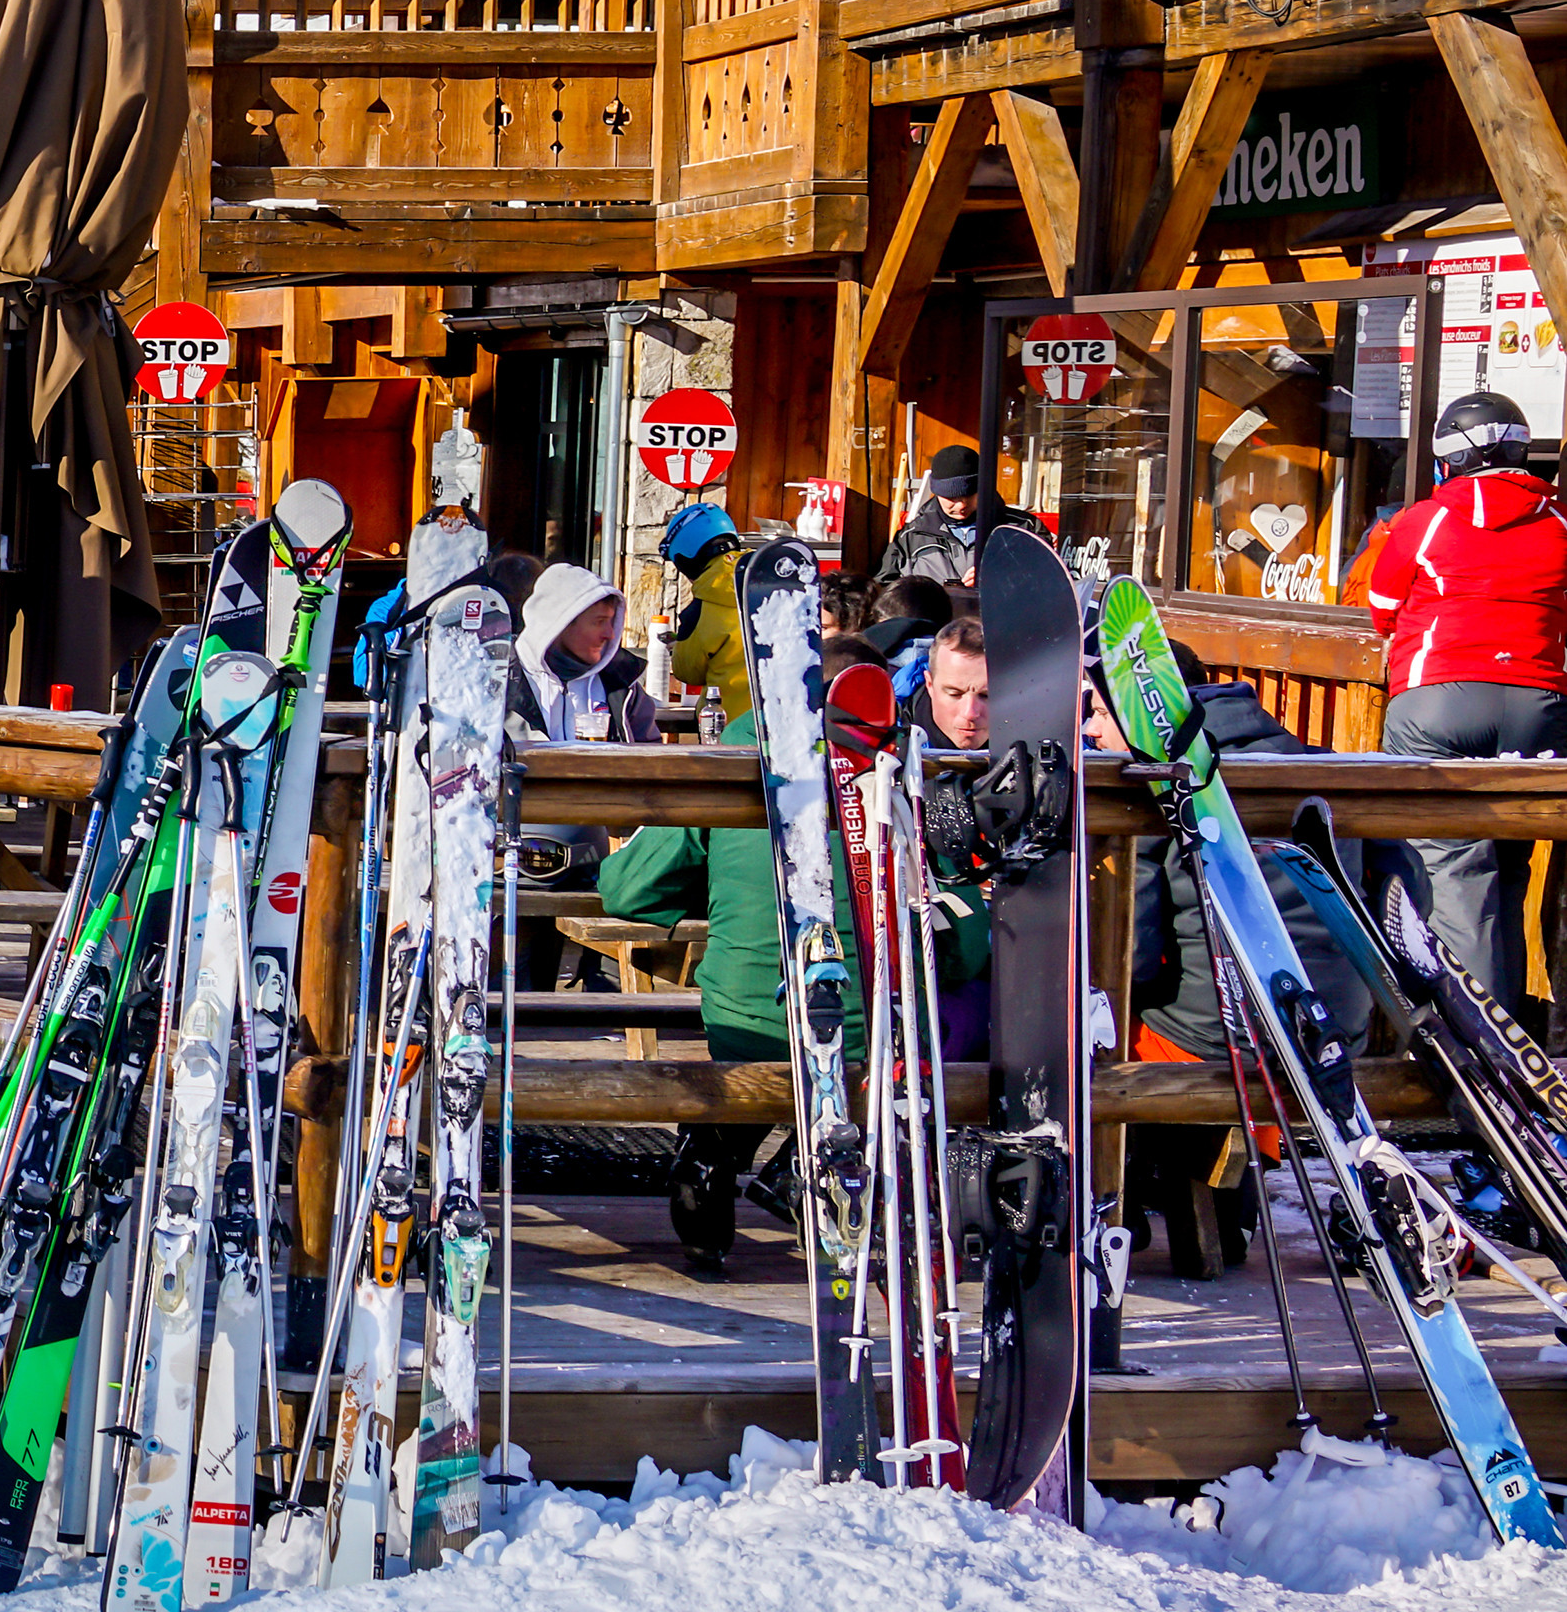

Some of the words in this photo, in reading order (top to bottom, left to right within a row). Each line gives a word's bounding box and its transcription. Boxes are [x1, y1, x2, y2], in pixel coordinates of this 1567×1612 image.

[1212, 112, 1365, 207] neken
[141, 340, 219, 362] STOP
[648, 424, 727, 448] STOP
[1261, 552, 1325, 603] Coca-Cola
[210, 605, 265, 625] FISCHER
[834, 759, 850, 770] 143
[60, 959, 89, 1011] salomon
[1102, 1248, 1113, 1269] LOOK
[21, 1427, 41, 1467] 77
[9, 1478, 24, 1508] PRO
[15, 1479, 30, 1510] MTN
[1504, 1480, 1521, 1498] 87
[194, 1506, 249, 1521] ALPETTA
[206, 1556, 248, 1570] 180
